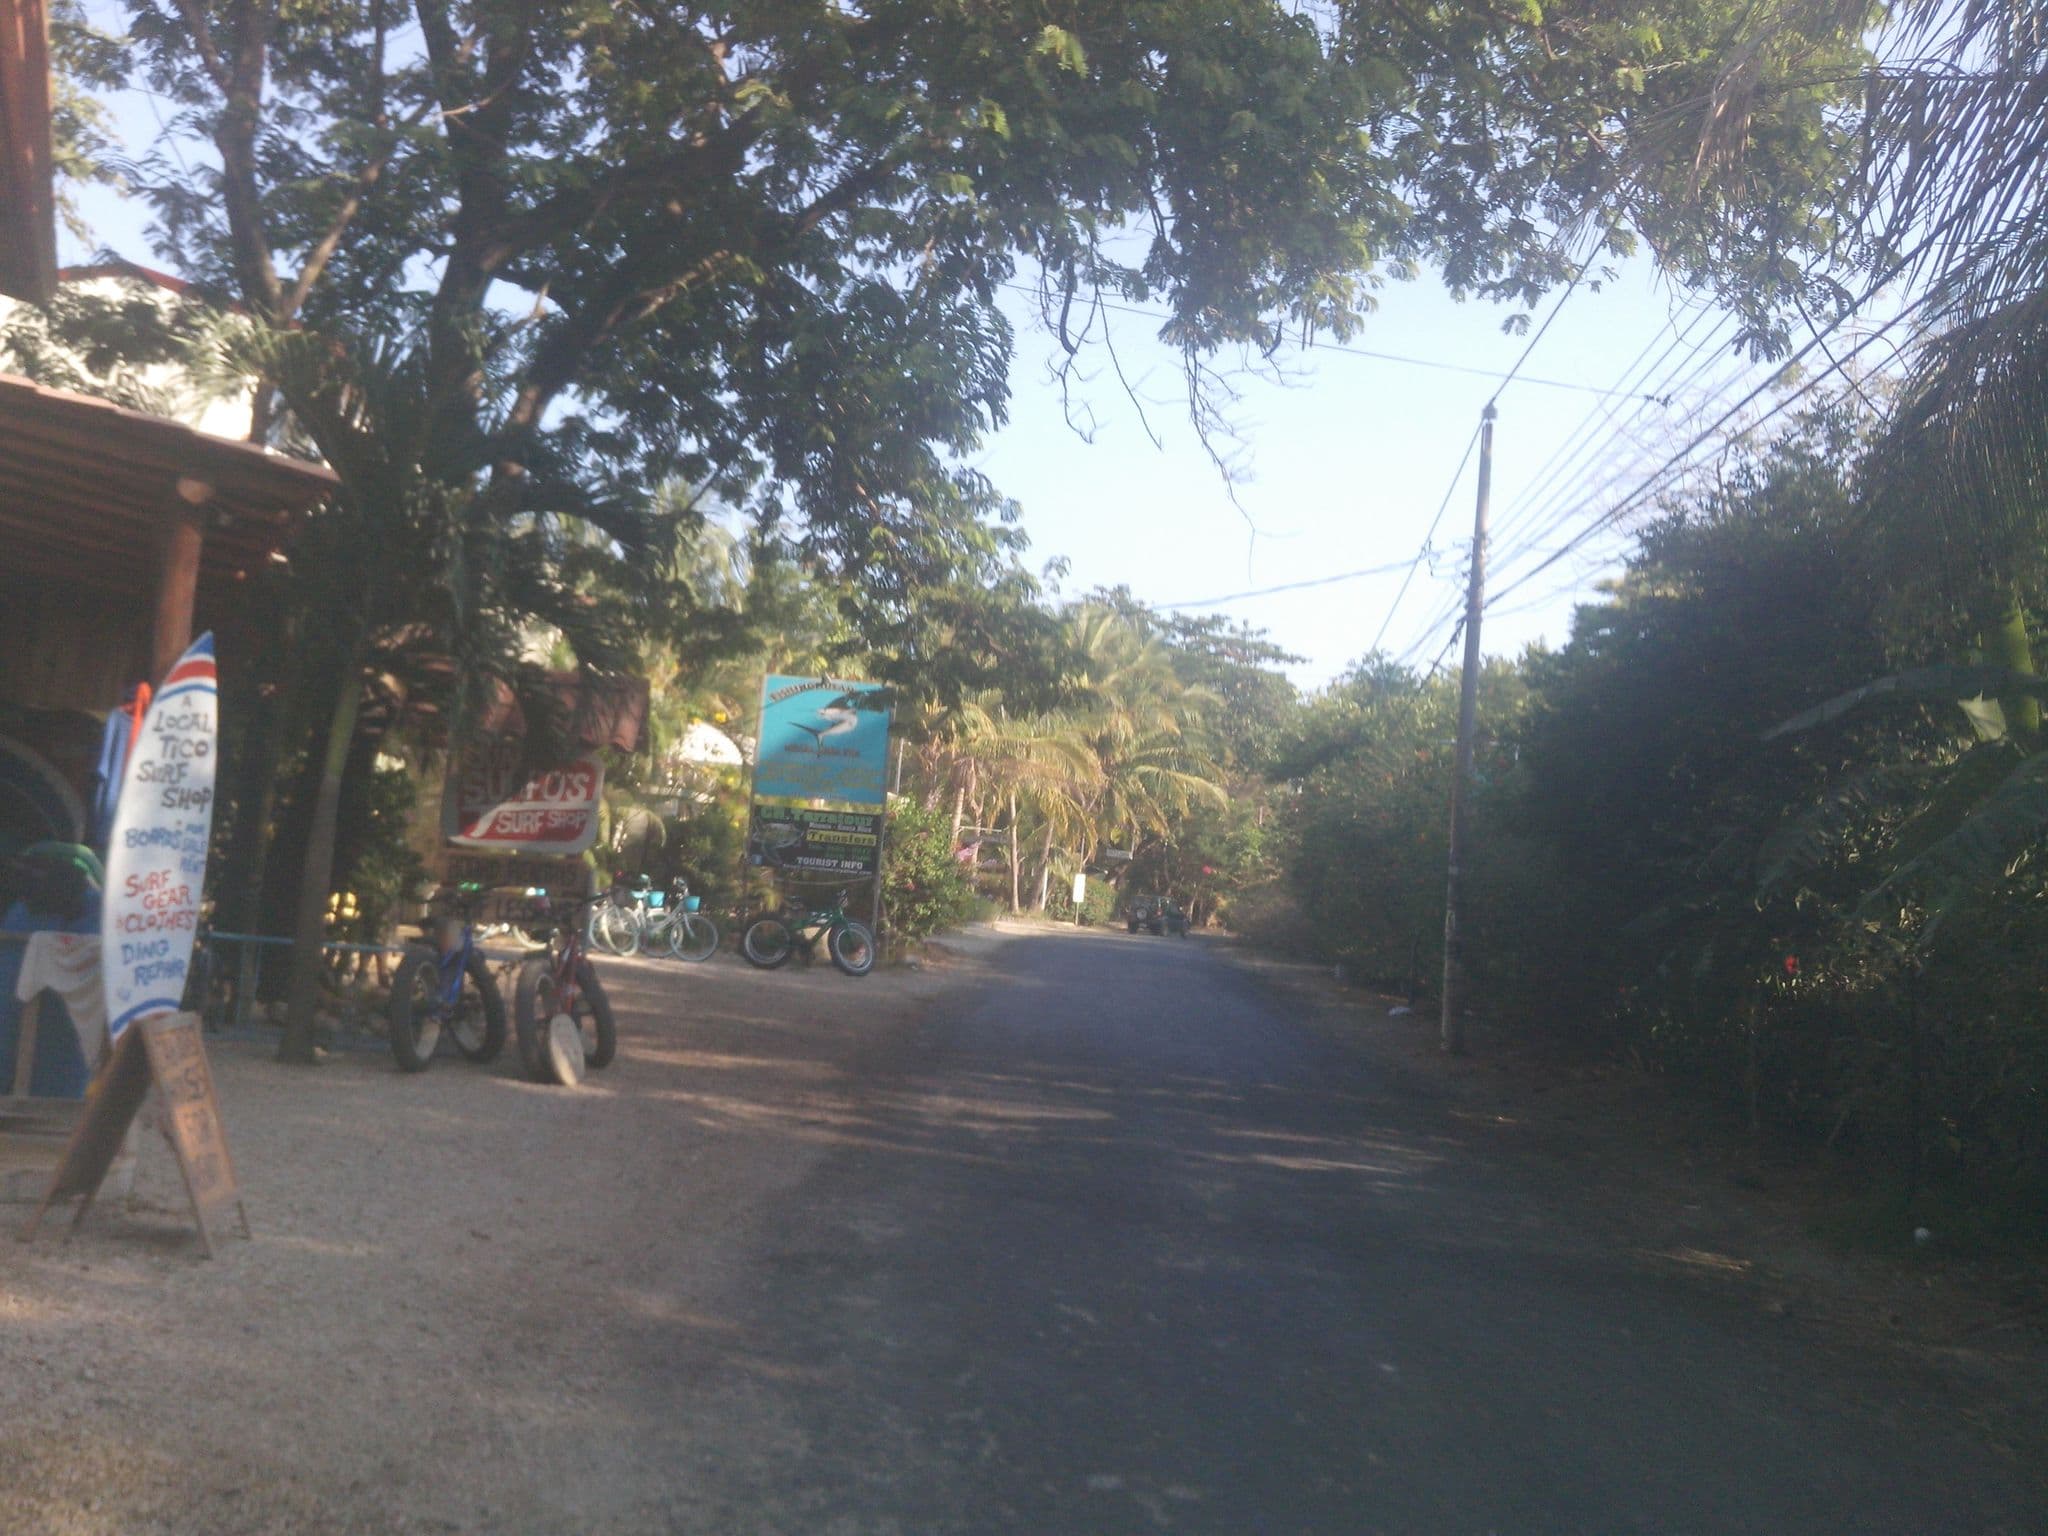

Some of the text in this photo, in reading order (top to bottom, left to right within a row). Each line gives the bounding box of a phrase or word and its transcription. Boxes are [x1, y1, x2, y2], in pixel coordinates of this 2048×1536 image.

[152, 711, 212, 733] LOCAL
[136, 760, 188, 784] SURF
[161, 786, 212, 813] SHOP
[495, 810, 588, 834] SURF SHOP
[796, 856, 839, 869] TOURIST
[840, 859, 863, 870] INFO
[124, 869, 172, 898] SURF
[143, 885, 193, 910] GEAR
